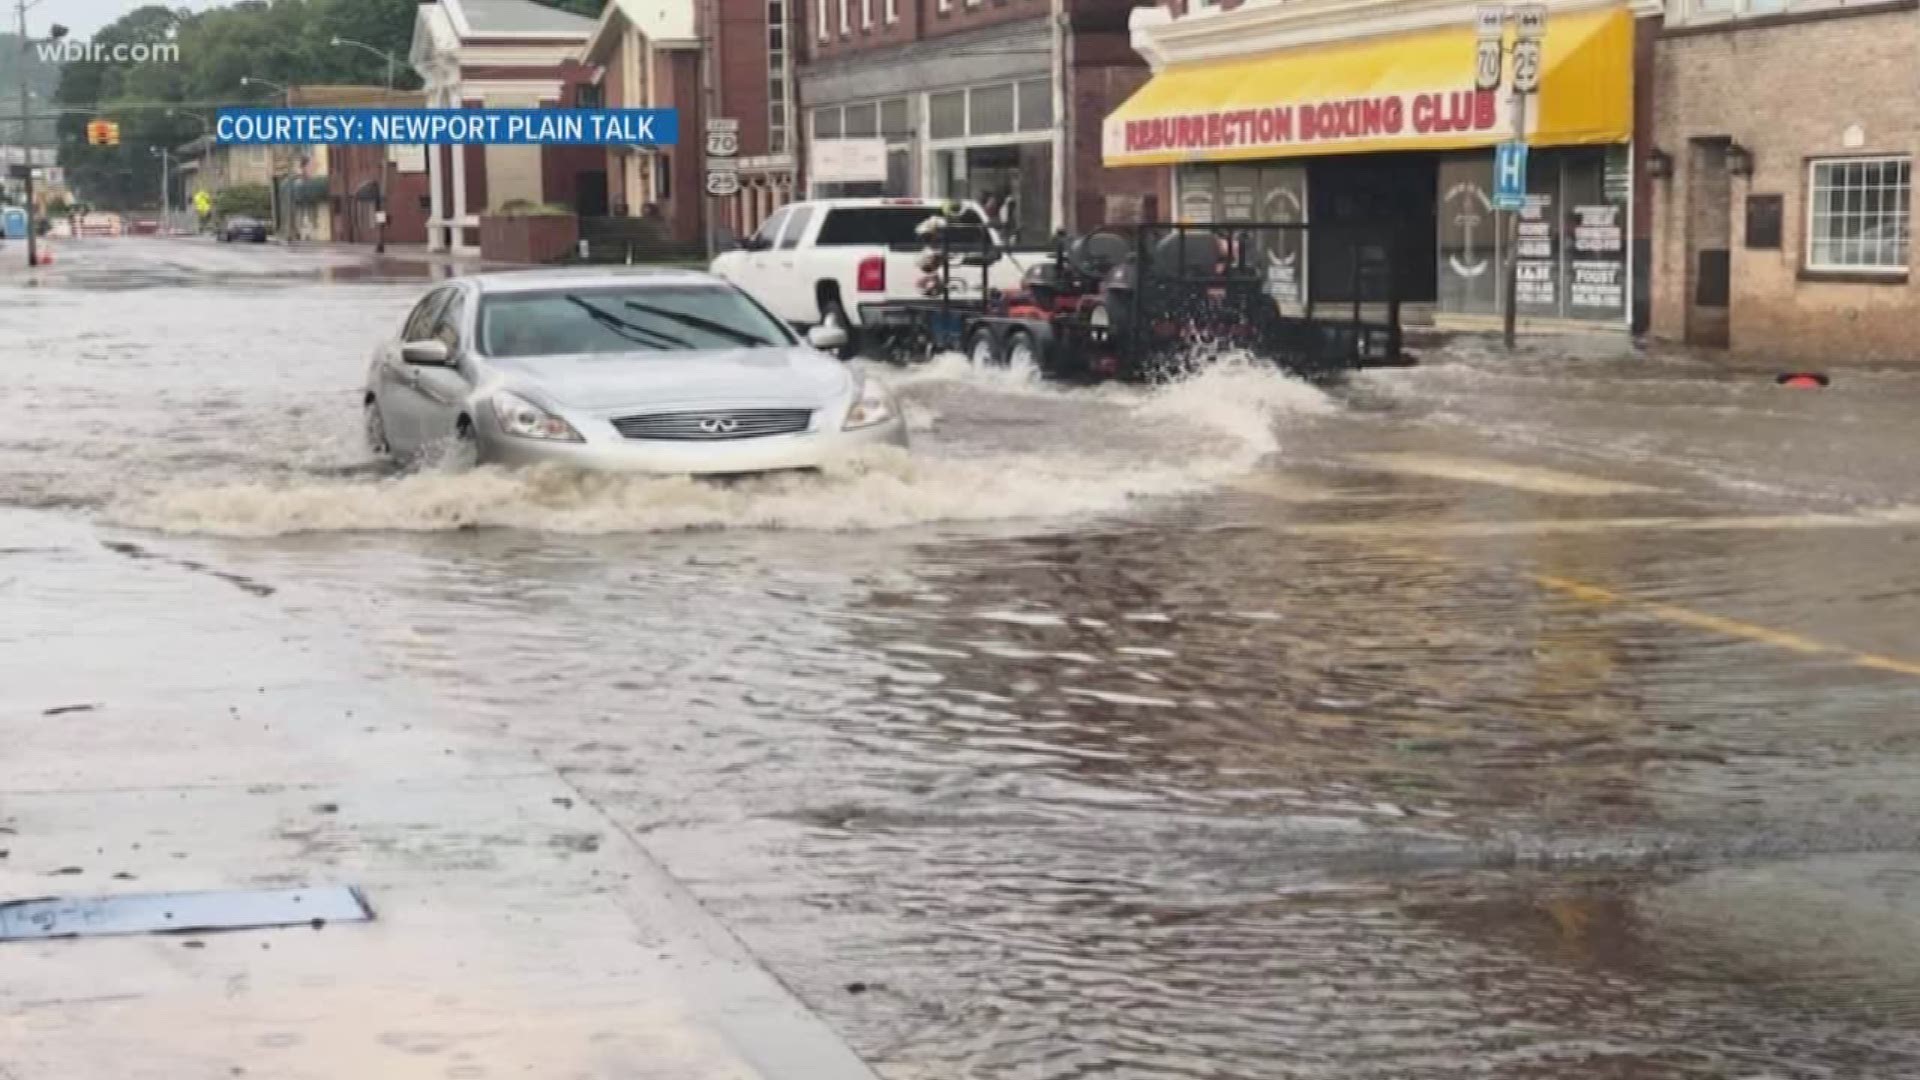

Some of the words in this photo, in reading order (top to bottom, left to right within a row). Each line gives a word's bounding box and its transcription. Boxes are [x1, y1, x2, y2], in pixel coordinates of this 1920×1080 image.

[1479, 49, 1497, 77] 70
[1515, 52, 1537, 80] 25
[1125, 106, 1292, 151] RESURRECTION
[1300, 96, 1403, 139] BOXING
[1412, 89, 1495, 132] CLUB
[710, 136, 735, 151] 70
[710, 175, 735, 189] 25
[1501, 149, 1519, 188] H
